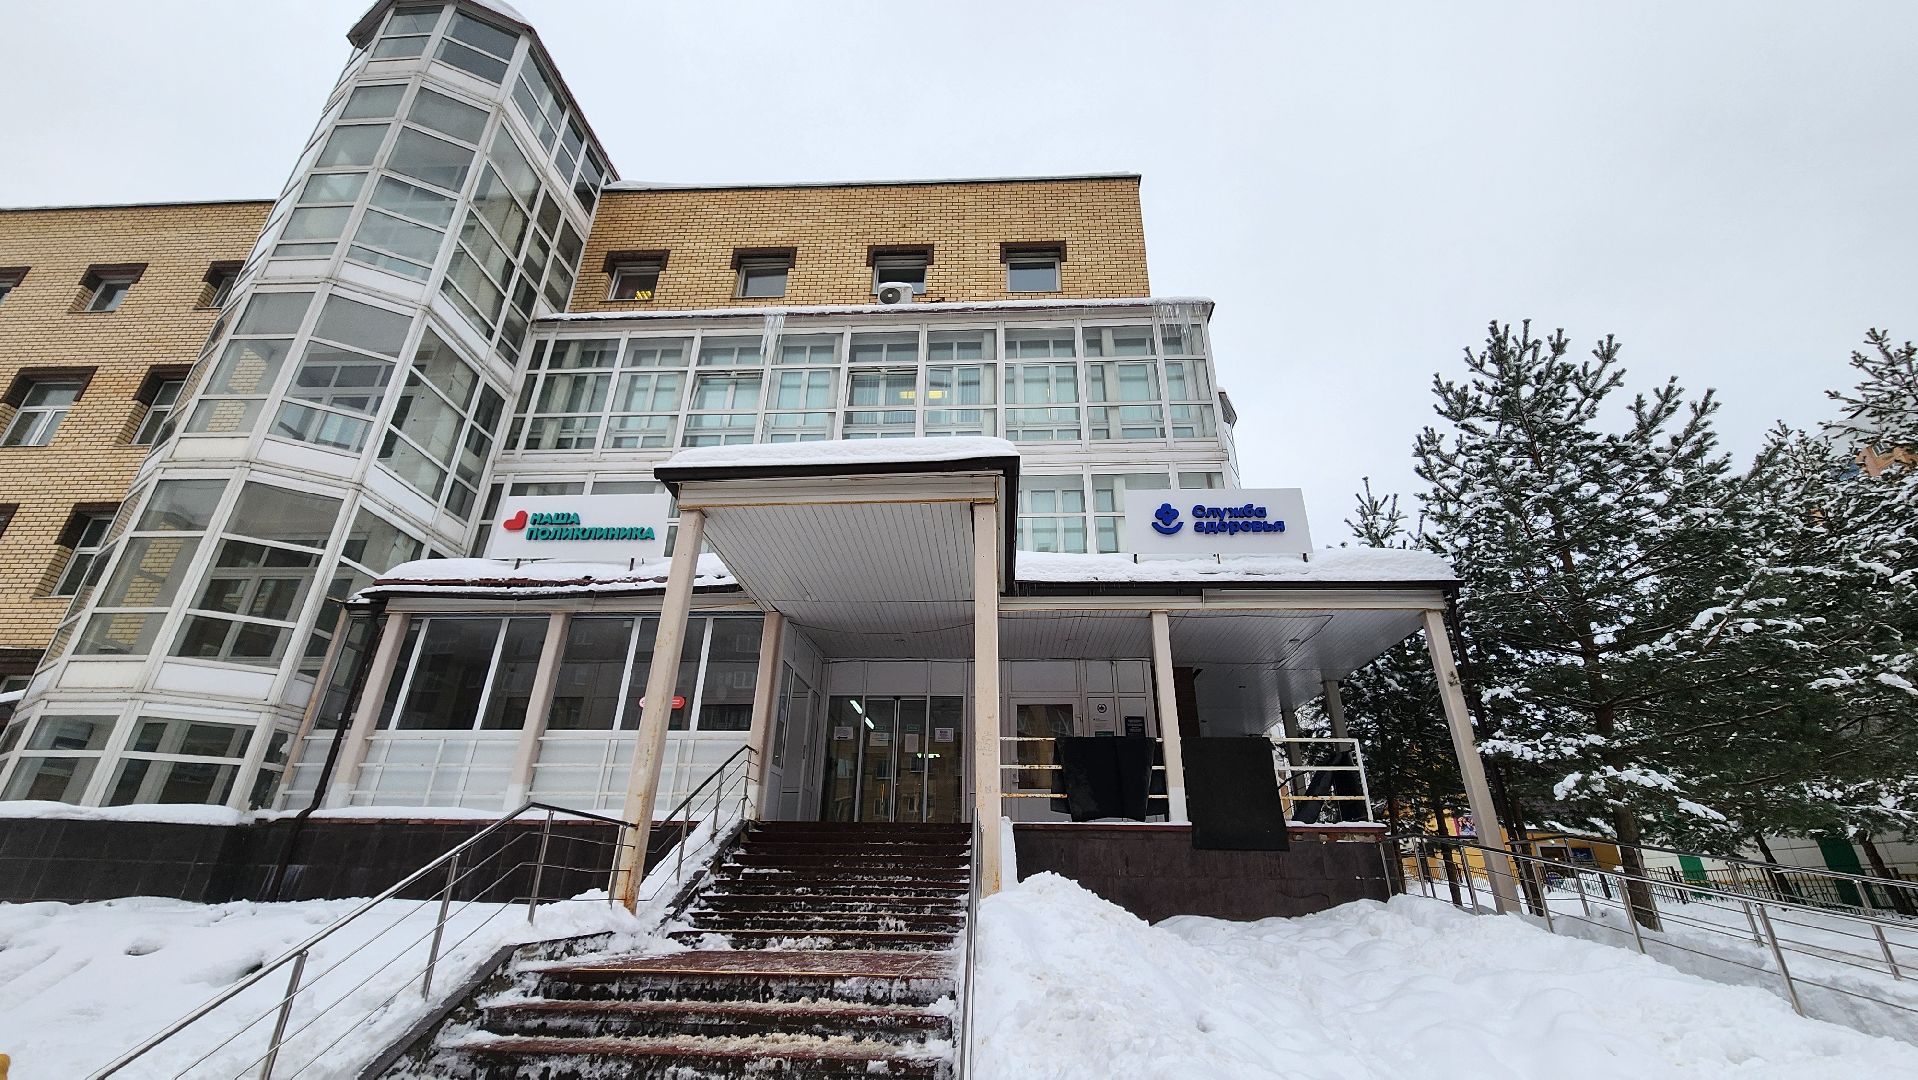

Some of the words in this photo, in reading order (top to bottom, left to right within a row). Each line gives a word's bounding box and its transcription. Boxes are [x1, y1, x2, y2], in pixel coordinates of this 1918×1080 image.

[529, 512, 580, 525] НАША
[1192, 504, 1267, 520] Служба
[526, 527, 655, 541] ПОЛИКЛИНИКА
[1194, 520, 1286, 535] здоровья
